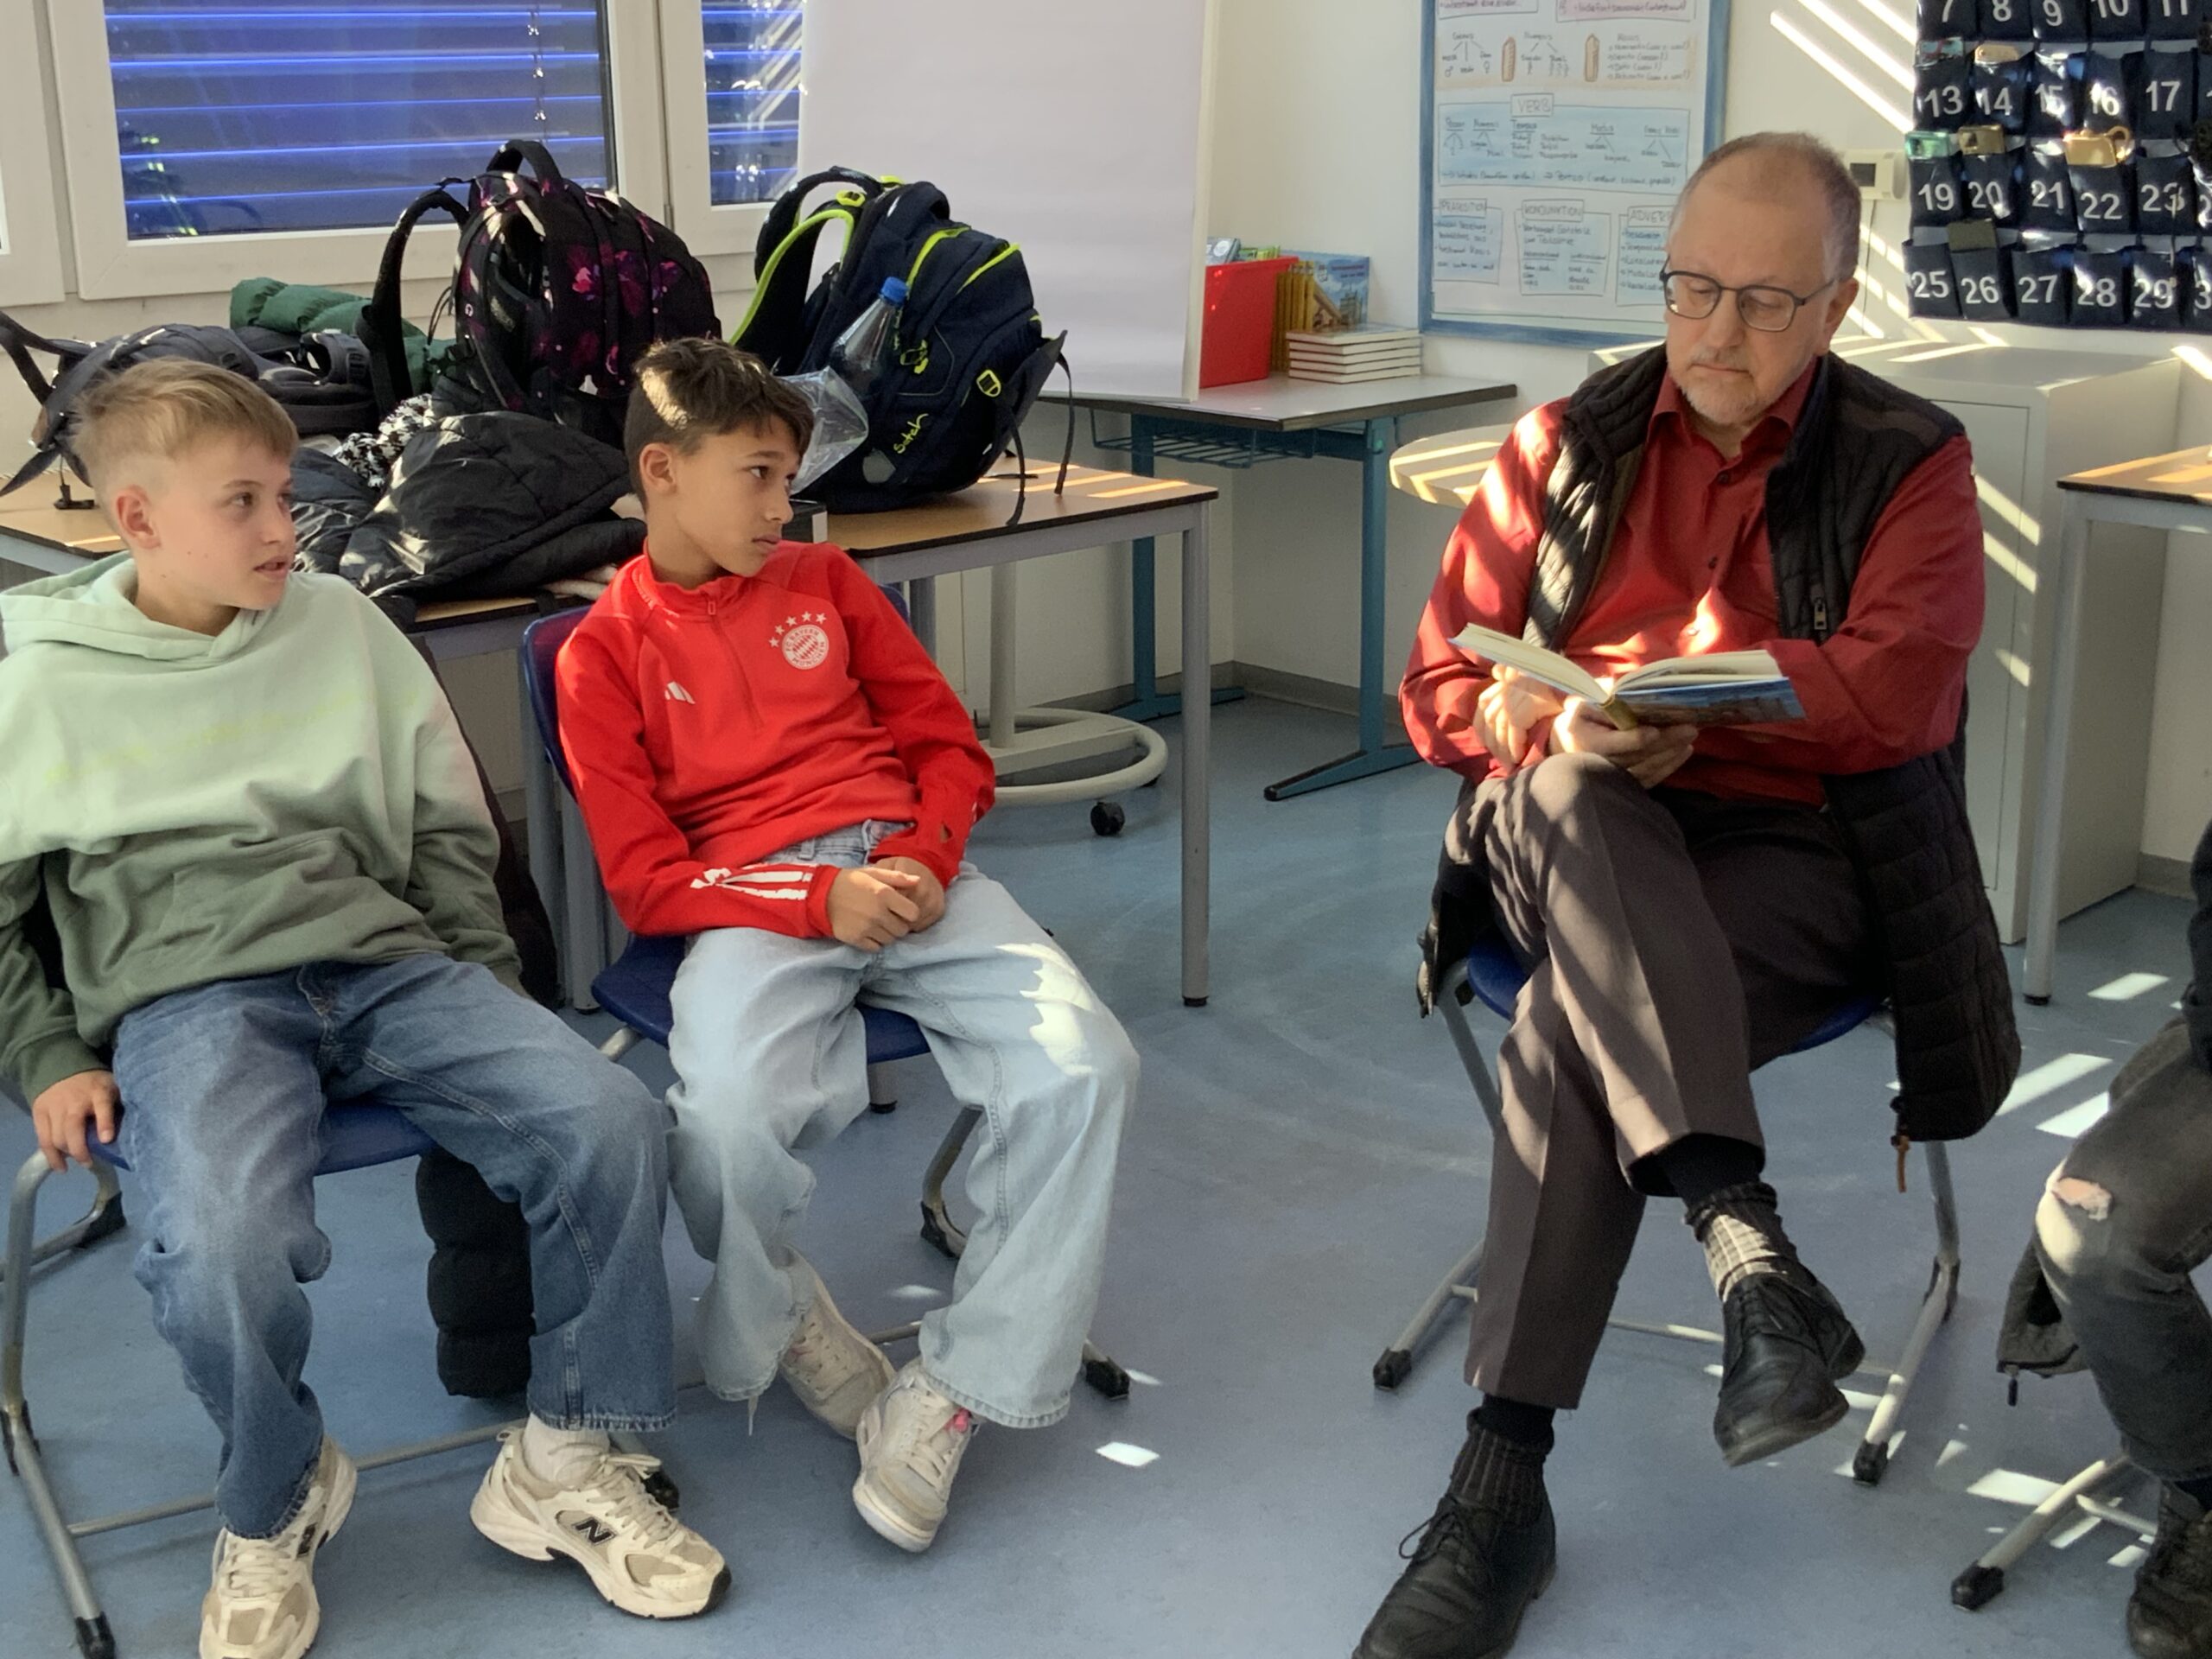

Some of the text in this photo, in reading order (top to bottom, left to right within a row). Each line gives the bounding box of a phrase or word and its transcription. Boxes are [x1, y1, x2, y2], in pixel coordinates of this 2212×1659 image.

[1993, 0, 2012, 22] 8
[2043, 0, 2063, 27] 9
[1517, 99, 1551, 113] VERB
[1924, 86, 1963, 118] 13
[1977, 86, 2013, 116] 14
[2034, 83, 2066, 116] 15
[2089, 83, 2120, 116] 16
[2145, 80, 2181, 112] 17
[1917, 183, 1955, 212] 19
[1967, 181, 2005, 212] 20
[2031, 180, 2066, 210] 21
[2080, 192, 2122, 220] 22
[2140, 182, 2185, 213] 23
[1910, 270, 1950, 299] 25
[1961, 276, 2000, 304] 26
[2018, 275, 2058, 302] 27
[2076, 277, 2116, 308] 28
[2133, 277, 2173, 309] 29
[789, 628, 820, 640] BAYERN
